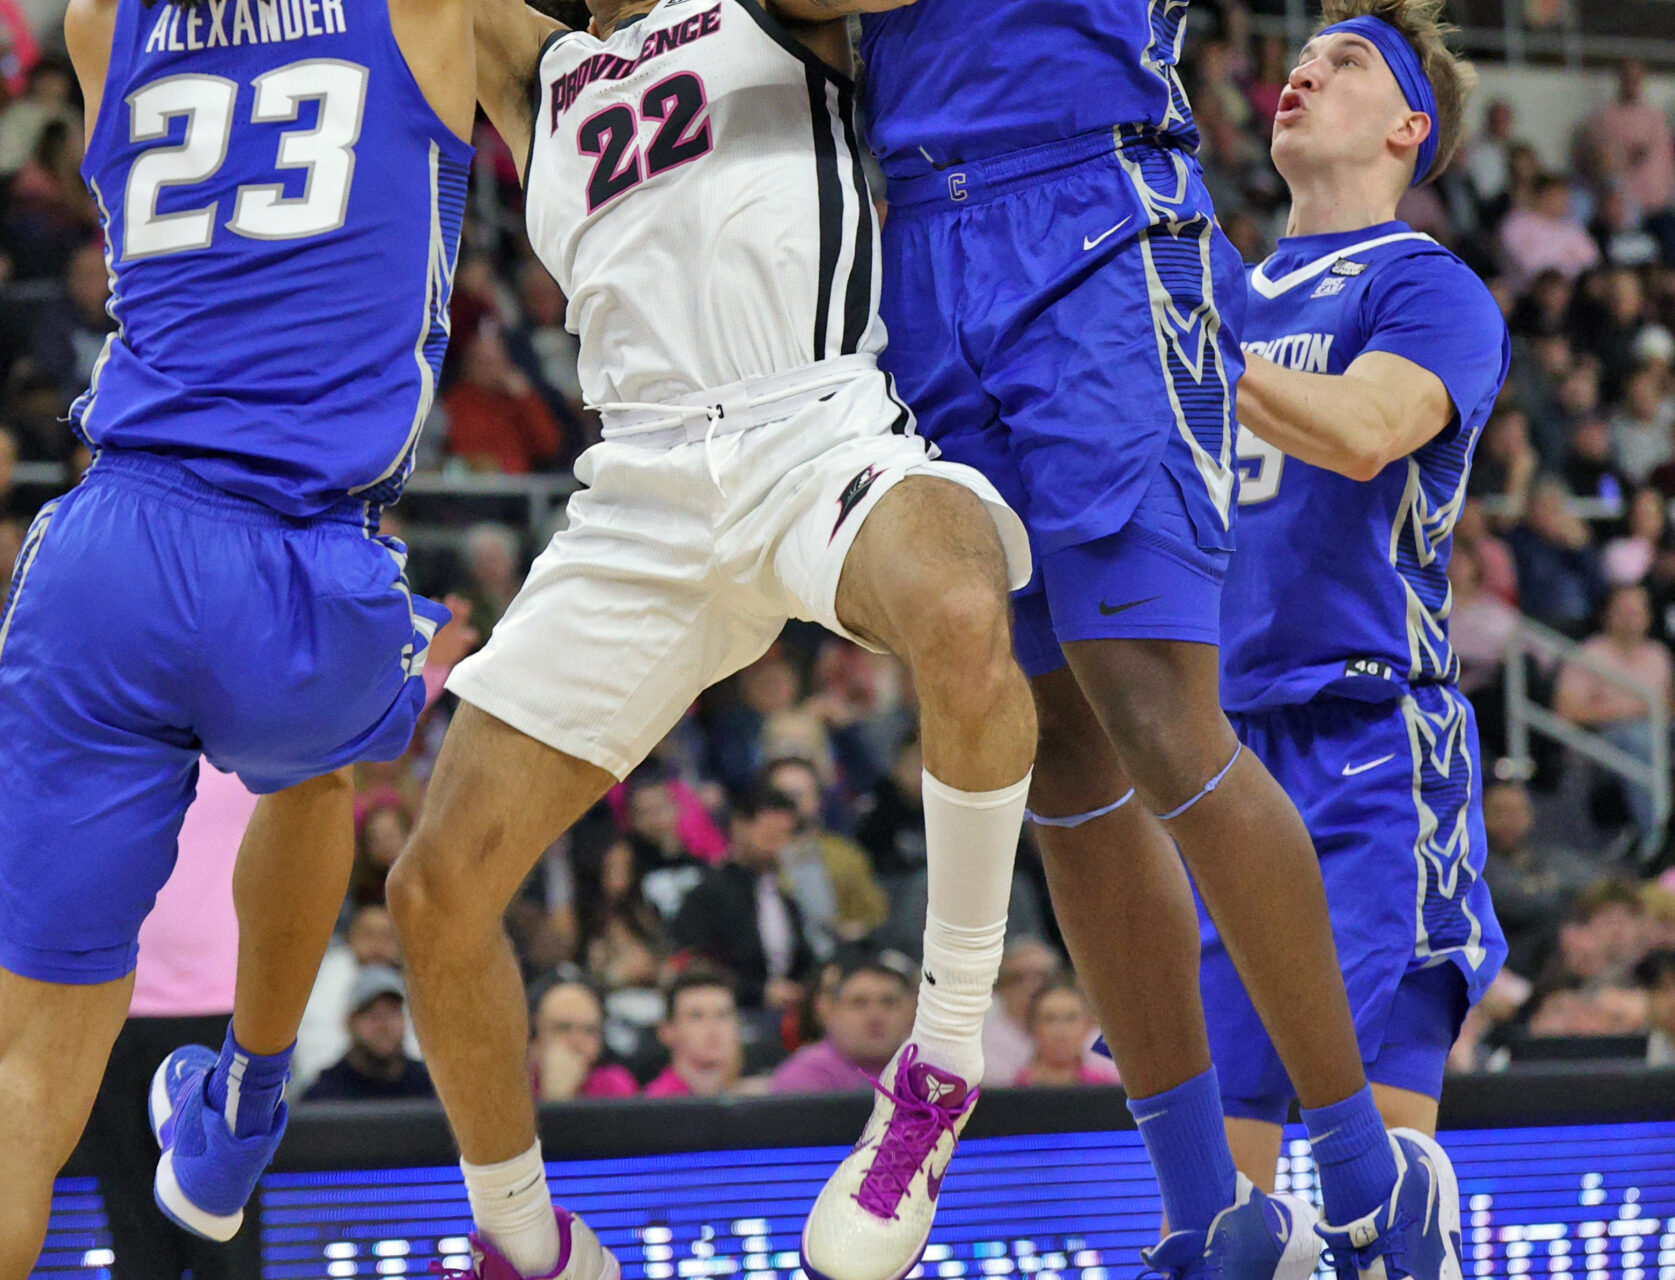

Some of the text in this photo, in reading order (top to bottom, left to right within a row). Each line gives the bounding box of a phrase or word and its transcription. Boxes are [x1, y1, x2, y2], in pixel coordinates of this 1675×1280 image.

[121, 57, 369, 261] 23
[576, 70, 713, 216] 22
[1354, 660, 1379, 675] 46
